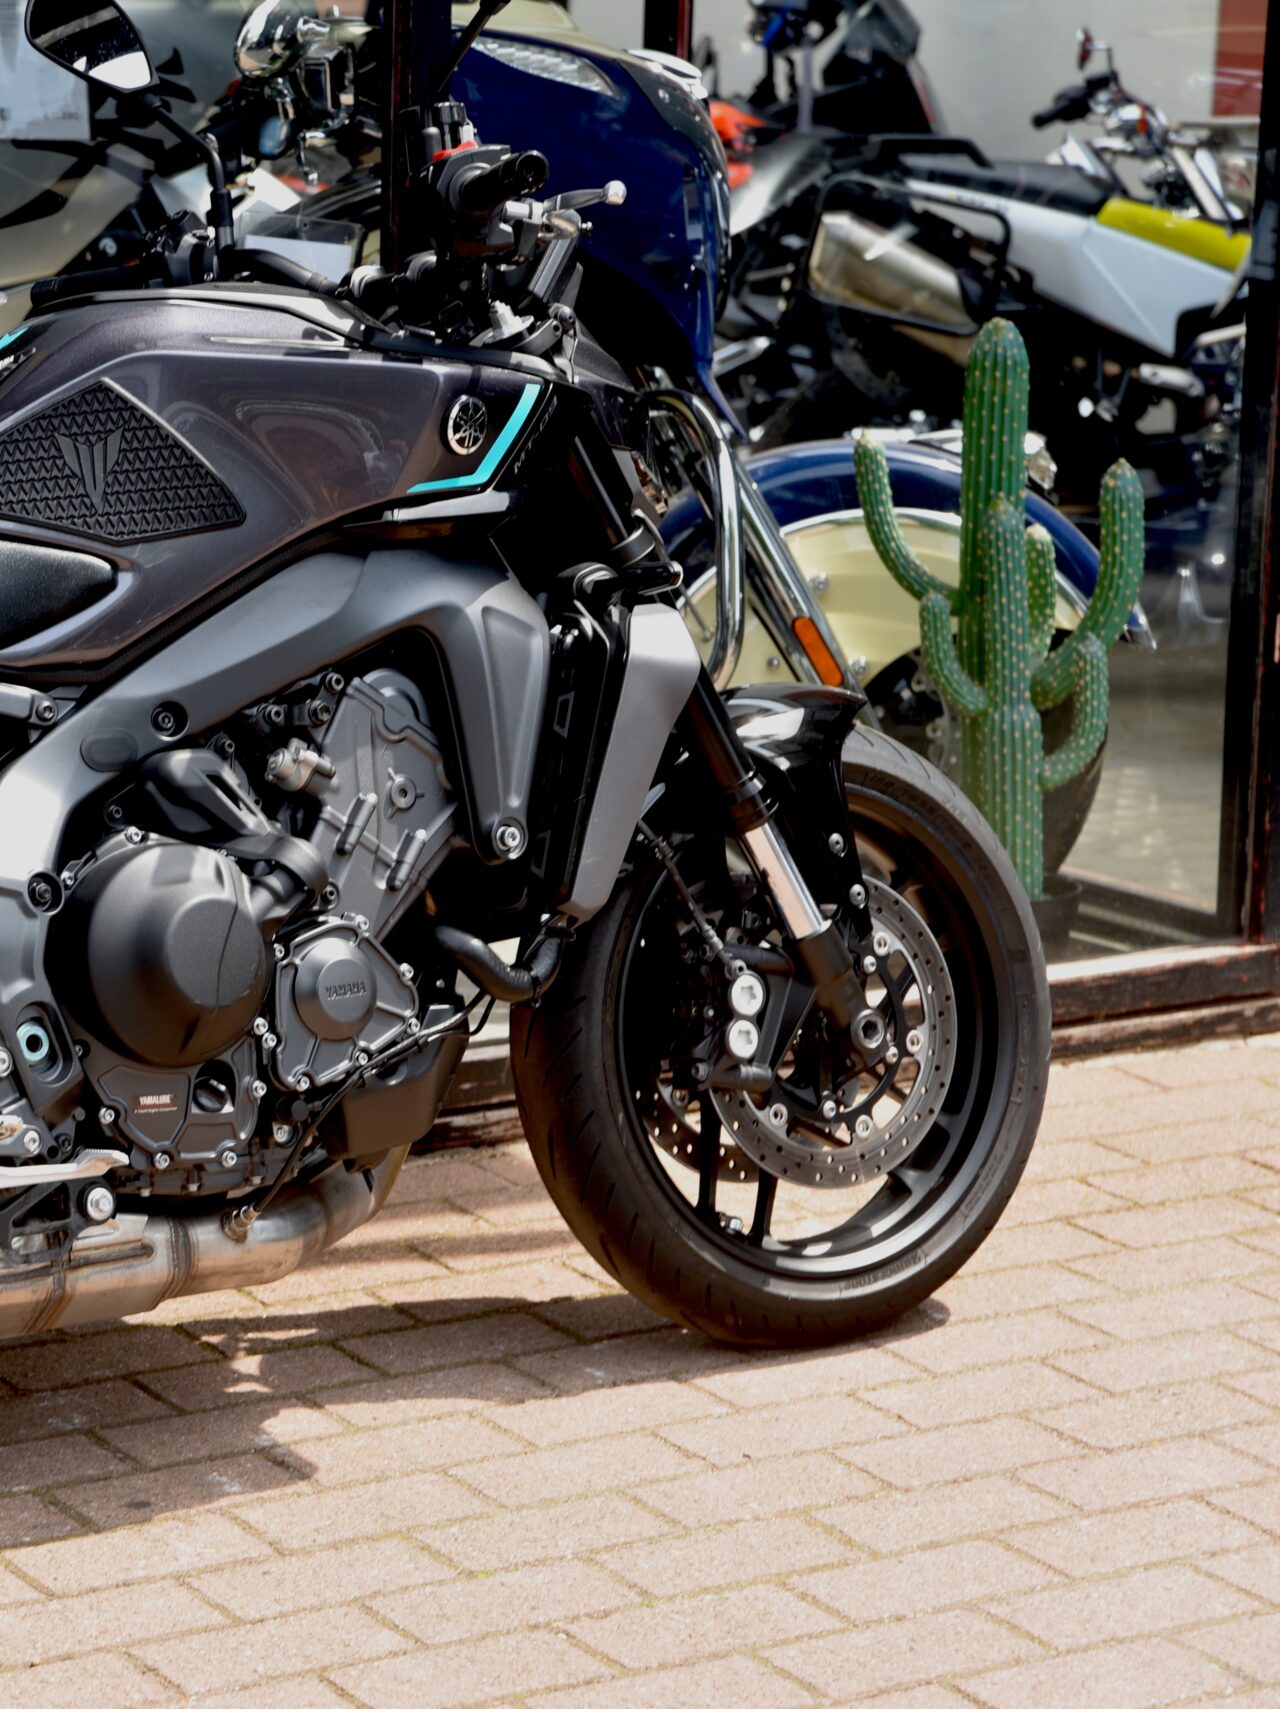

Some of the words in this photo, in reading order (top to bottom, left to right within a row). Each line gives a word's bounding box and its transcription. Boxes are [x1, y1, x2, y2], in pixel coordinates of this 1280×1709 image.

[513, 395, 559, 475] MT-09
[324, 980, 368, 1001] YAMAHA
[139, 1094, 172, 1106] YAMALUBE
